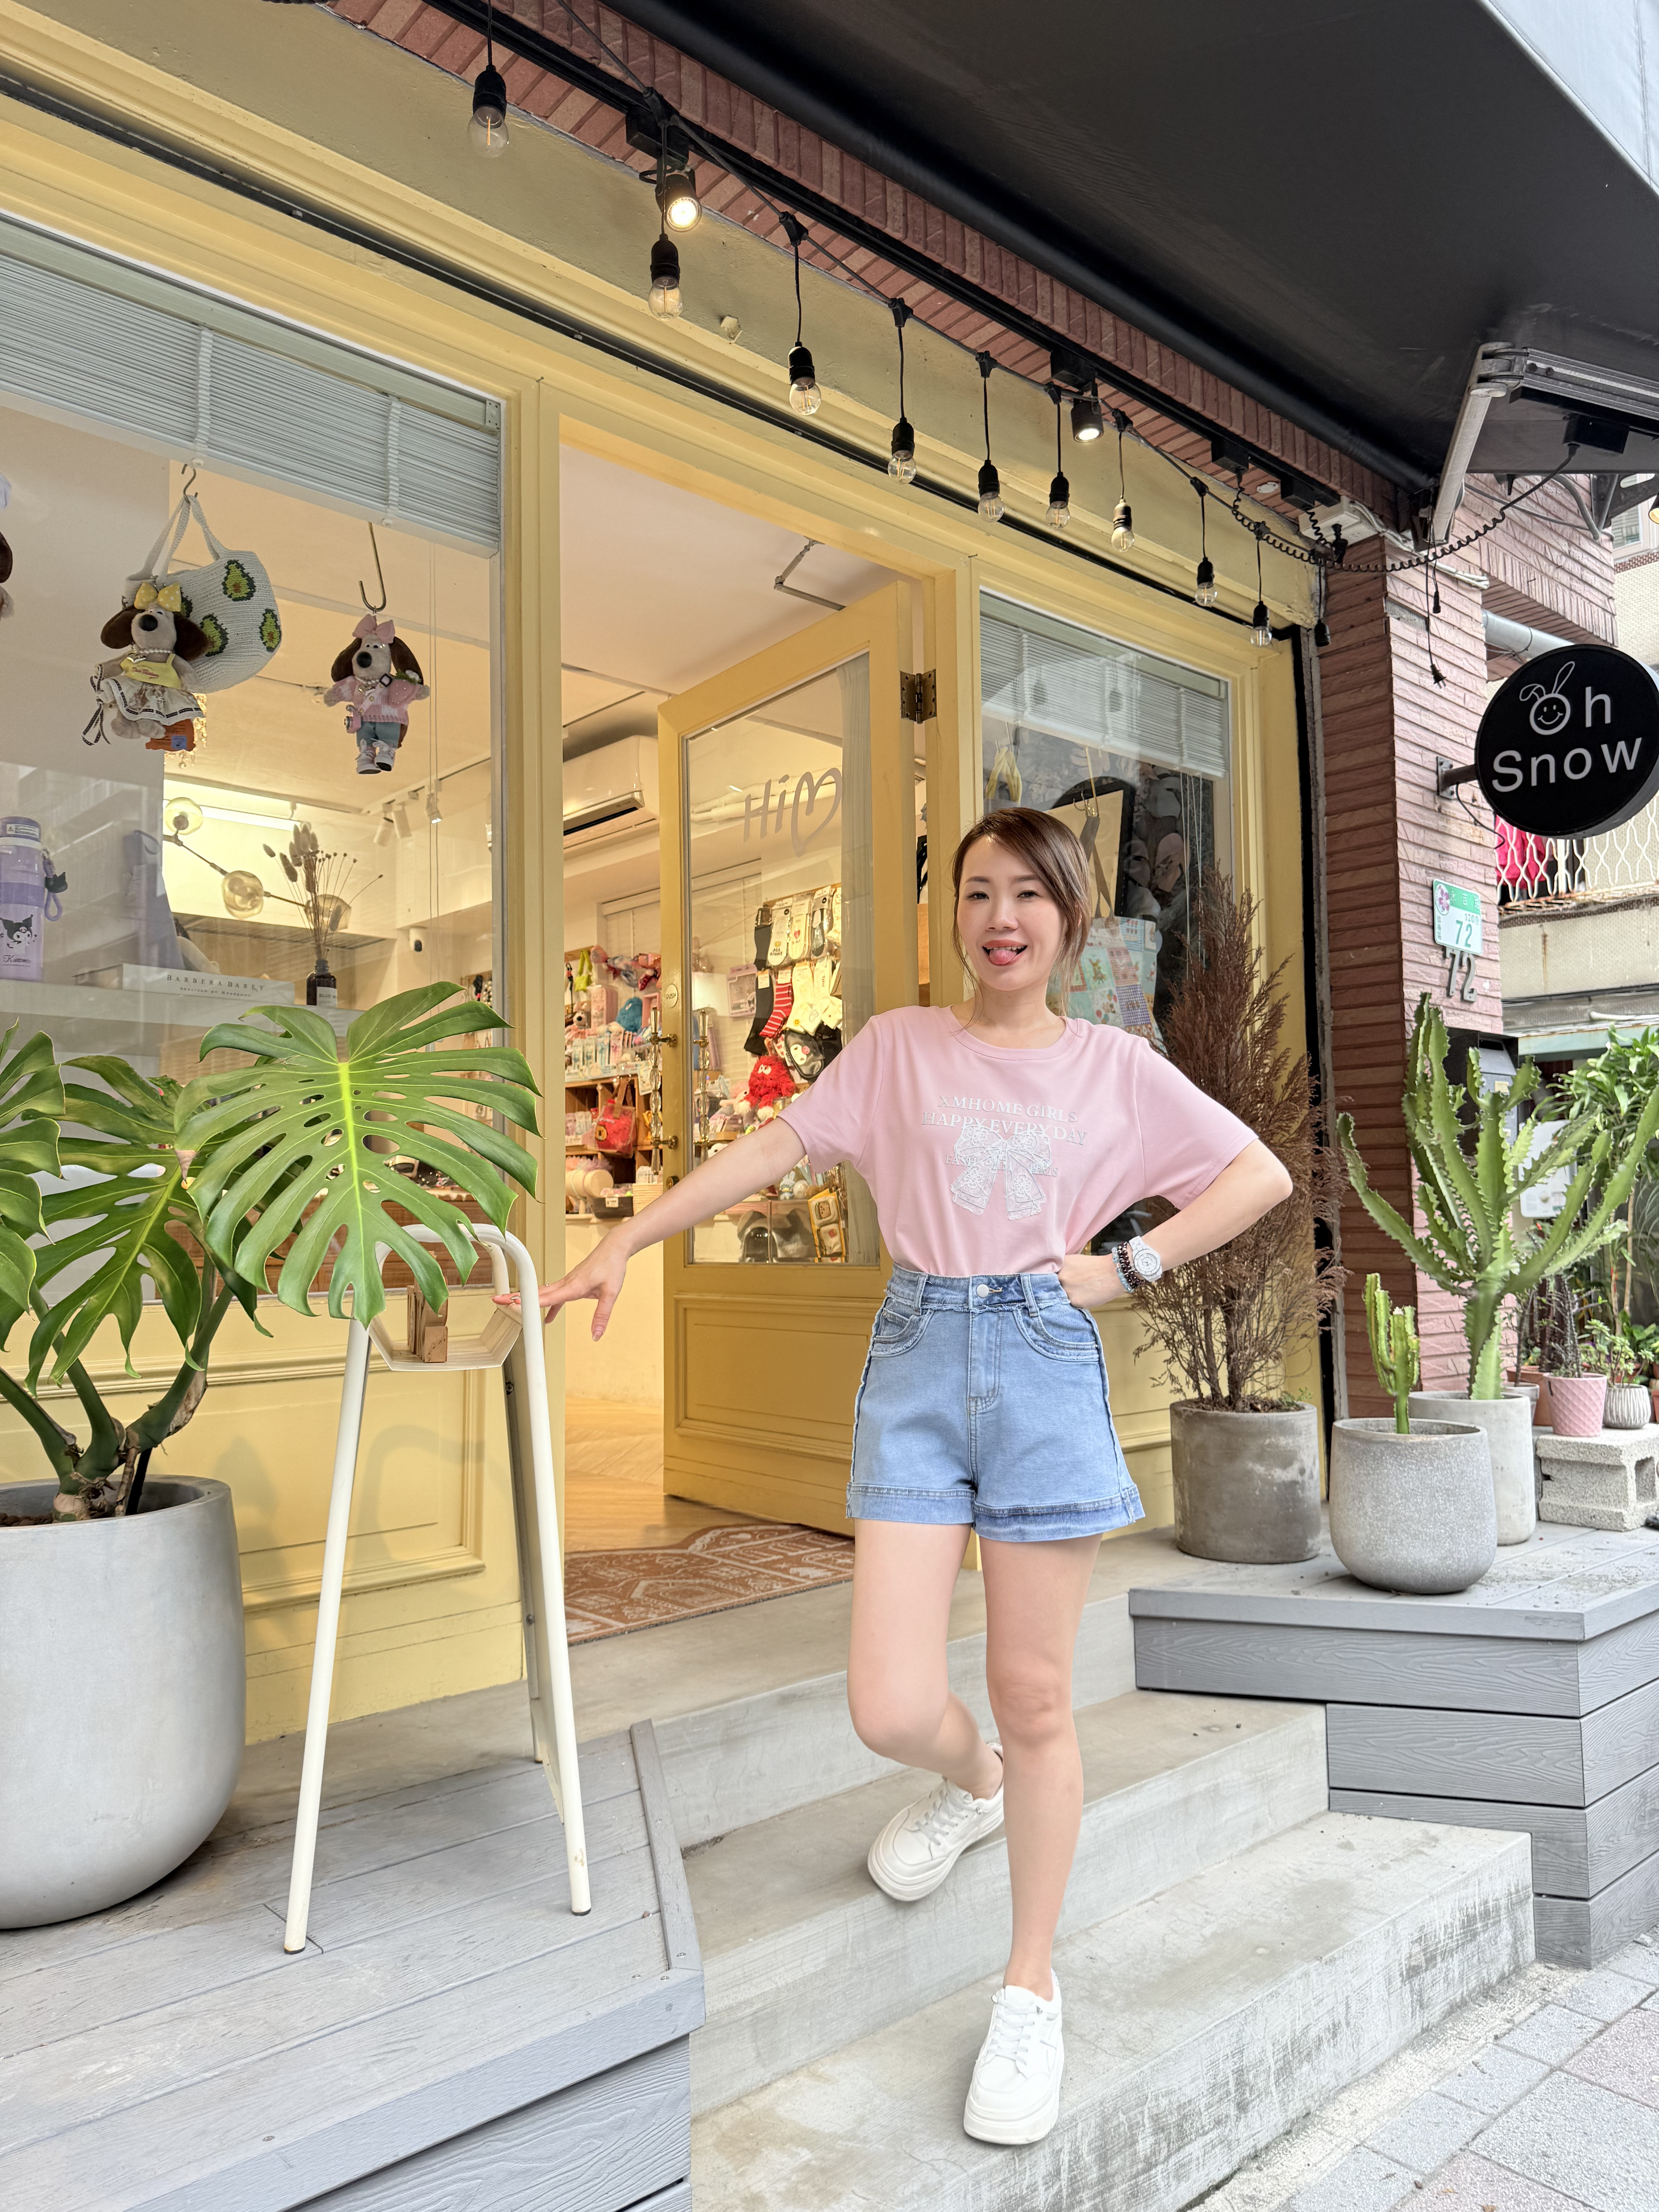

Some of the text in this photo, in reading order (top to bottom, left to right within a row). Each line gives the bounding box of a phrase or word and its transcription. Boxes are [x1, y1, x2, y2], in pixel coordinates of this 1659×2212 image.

[1530, 686, 1611, 735] Oh
[1492, 737, 1642, 792] Snow
[1455, 920, 1472, 948] 72
[167, 974, 222, 986] BARBERA
[1446, 946, 1477, 1002] 72
[922, 1112, 987, 1130] HAPPY
[937, 1096, 1078, 1122] XMHOME GIRLS
